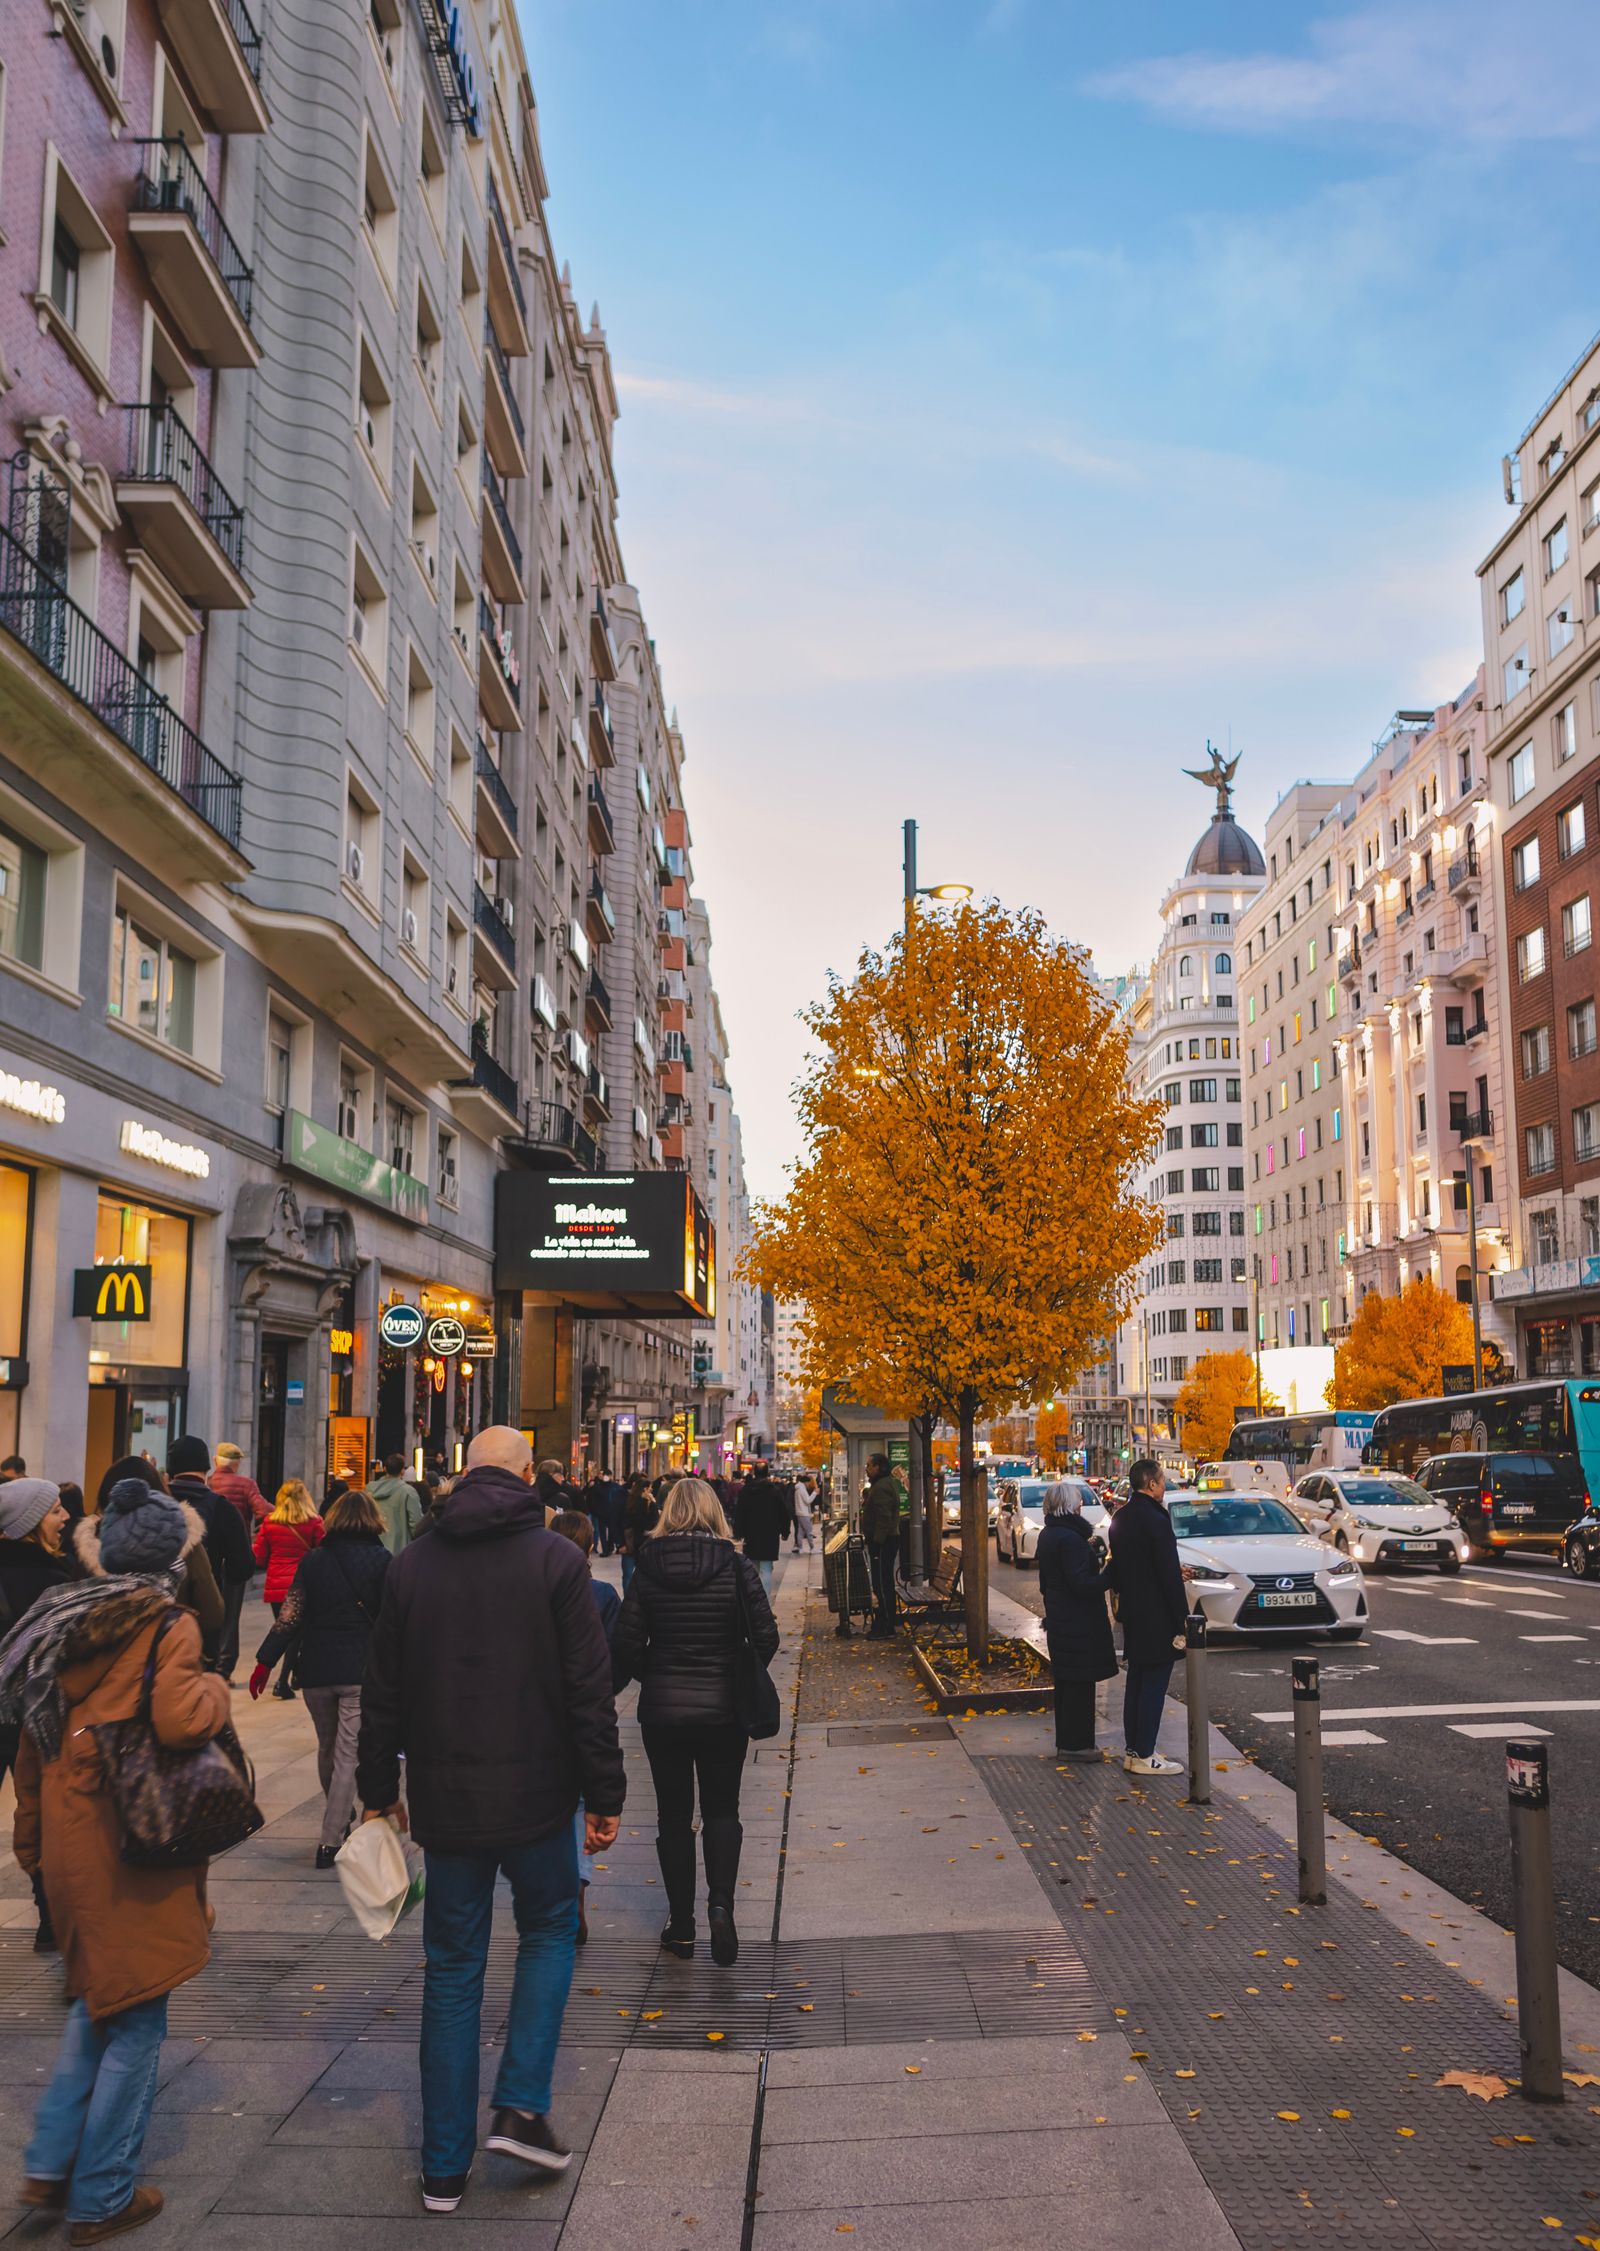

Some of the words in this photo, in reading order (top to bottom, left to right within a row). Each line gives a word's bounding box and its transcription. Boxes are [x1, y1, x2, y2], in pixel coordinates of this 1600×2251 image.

[554, 1203, 627, 1224] Mahou
[544, 1236, 558, 1247] La
[558, 1235, 580, 1247] vida
[581, 1238, 593, 1247] es
[614, 1235, 636, 1247] vida
[530, 1247, 569, 1258] cuando
[569, 1249, 586, 1258] nos
[586, 1249, 650, 1258] encontramos
[331, 1329, 353, 1354] SHOP
[1450, 1409, 1473, 1431] MADRID
[1208, 1479, 1224, 1489] TAXI
[1265, 1595, 1291, 1606] 9934
[1294, 1594, 1313, 1605] KYD
